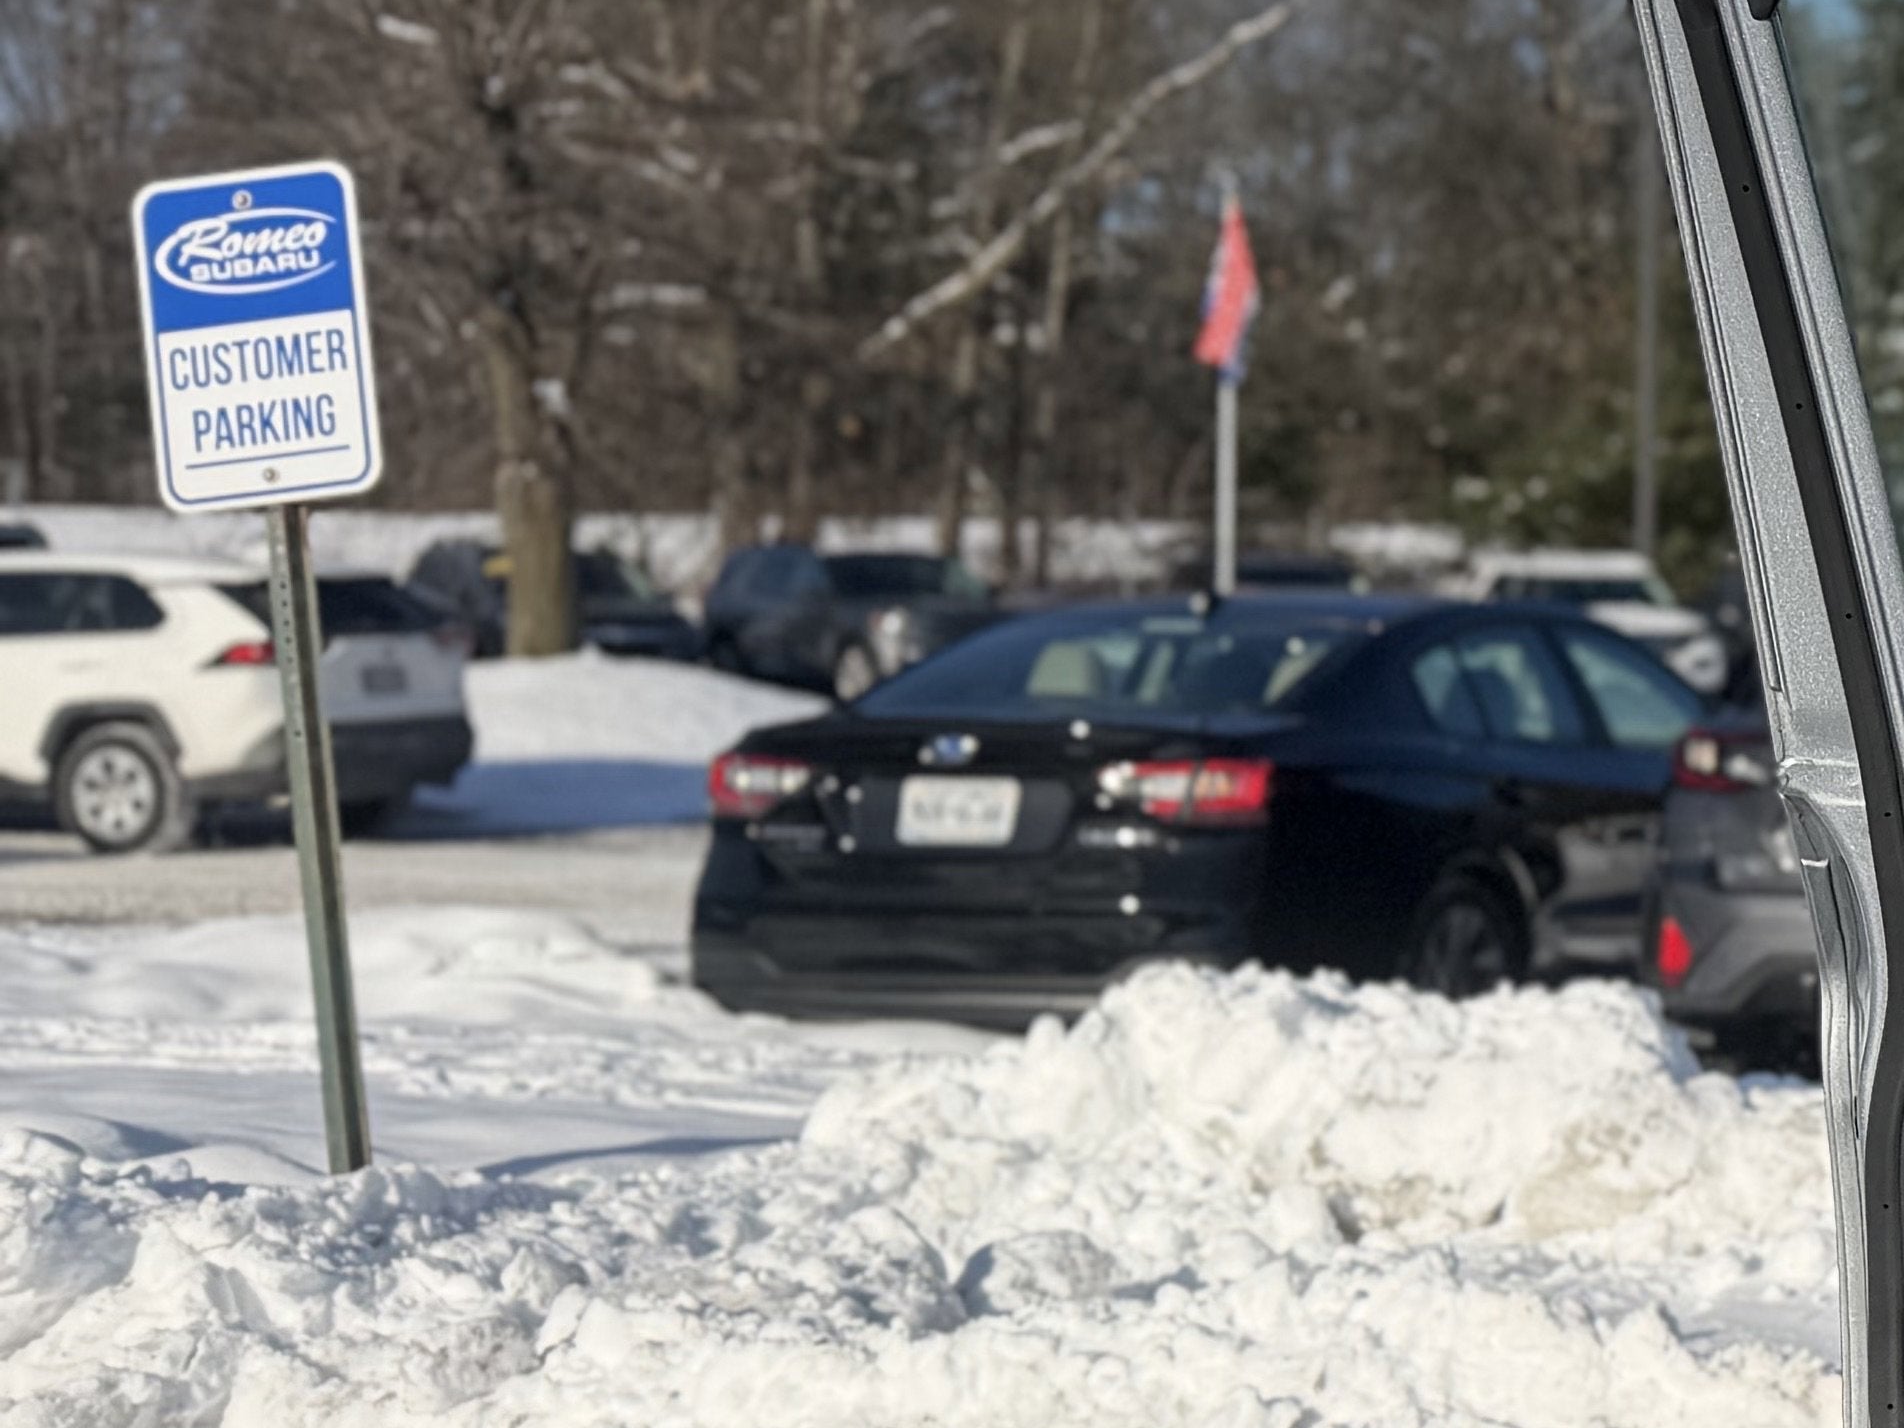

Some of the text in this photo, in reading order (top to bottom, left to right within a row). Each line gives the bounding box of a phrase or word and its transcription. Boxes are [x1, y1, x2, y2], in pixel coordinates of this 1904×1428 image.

[178, 221, 326, 267] Romeo
[190, 249, 320, 282] SUBARU
[169, 329, 348, 391] CUSTOMER
[193, 394, 336, 452] PARKING
